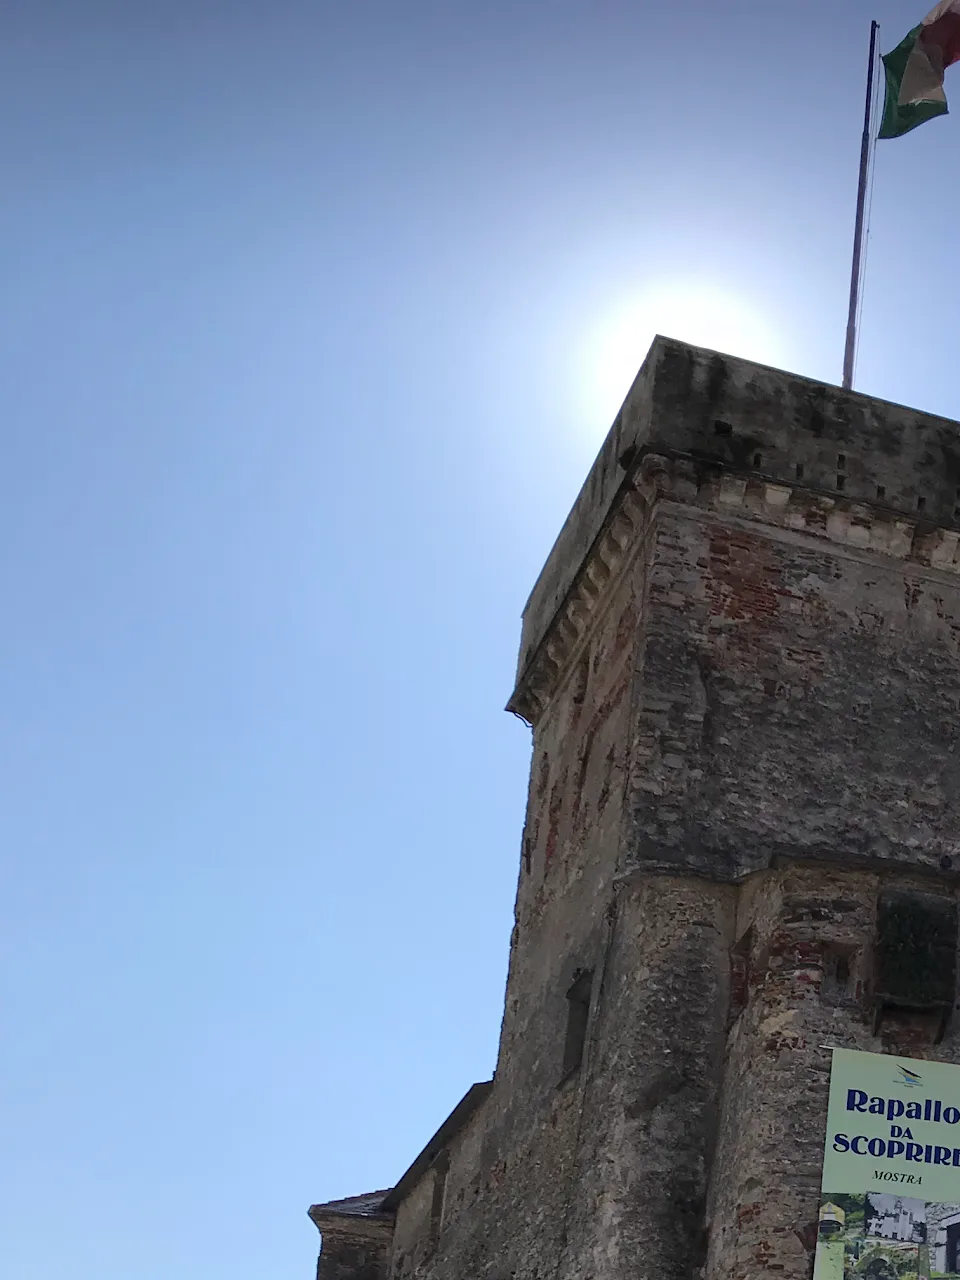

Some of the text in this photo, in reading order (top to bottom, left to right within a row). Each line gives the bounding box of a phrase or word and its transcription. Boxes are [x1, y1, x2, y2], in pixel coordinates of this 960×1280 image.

[846, 1088, 960, 1125] Rapallo
[890, 1125, 914, 1140] DA
[873, 1170, 922, 1185] MOSTRA
